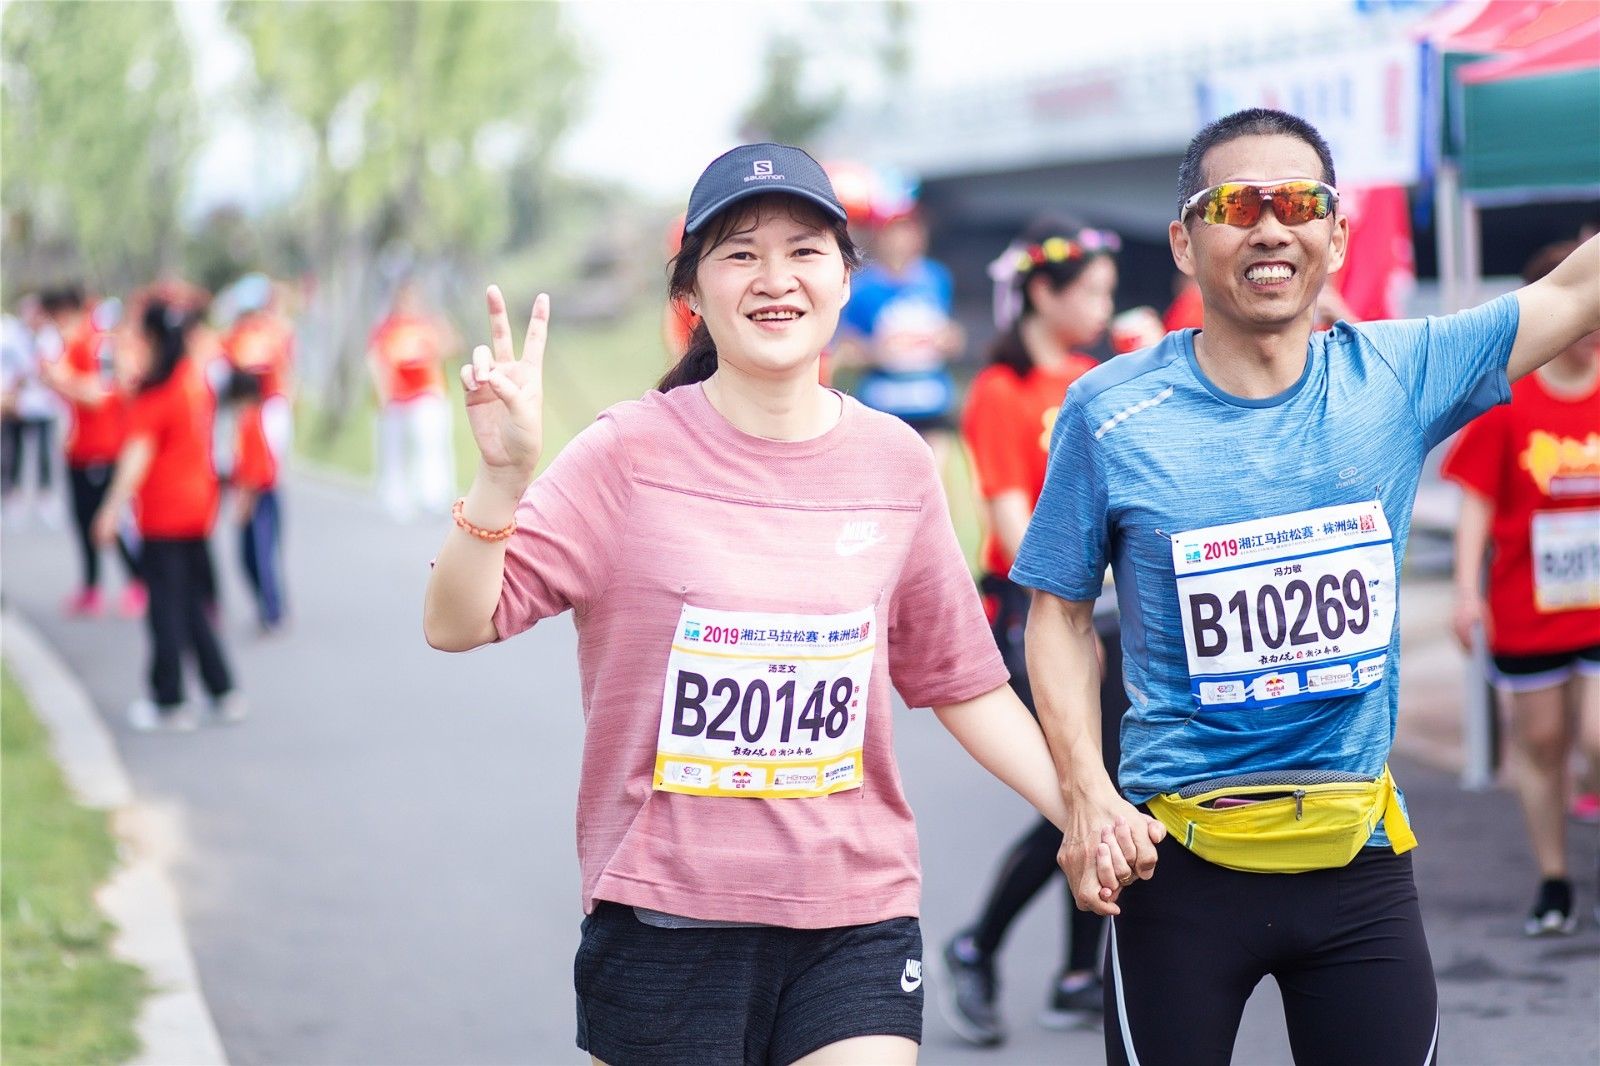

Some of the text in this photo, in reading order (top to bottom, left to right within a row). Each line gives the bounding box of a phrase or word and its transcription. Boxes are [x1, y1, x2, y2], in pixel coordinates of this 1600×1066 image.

[1273, 564, 1302, 577] 冯力敏
[1189, 569, 1370, 658] B10269
[768, 664, 797, 674] 汤芝文
[672, 669, 853, 743] B20148
